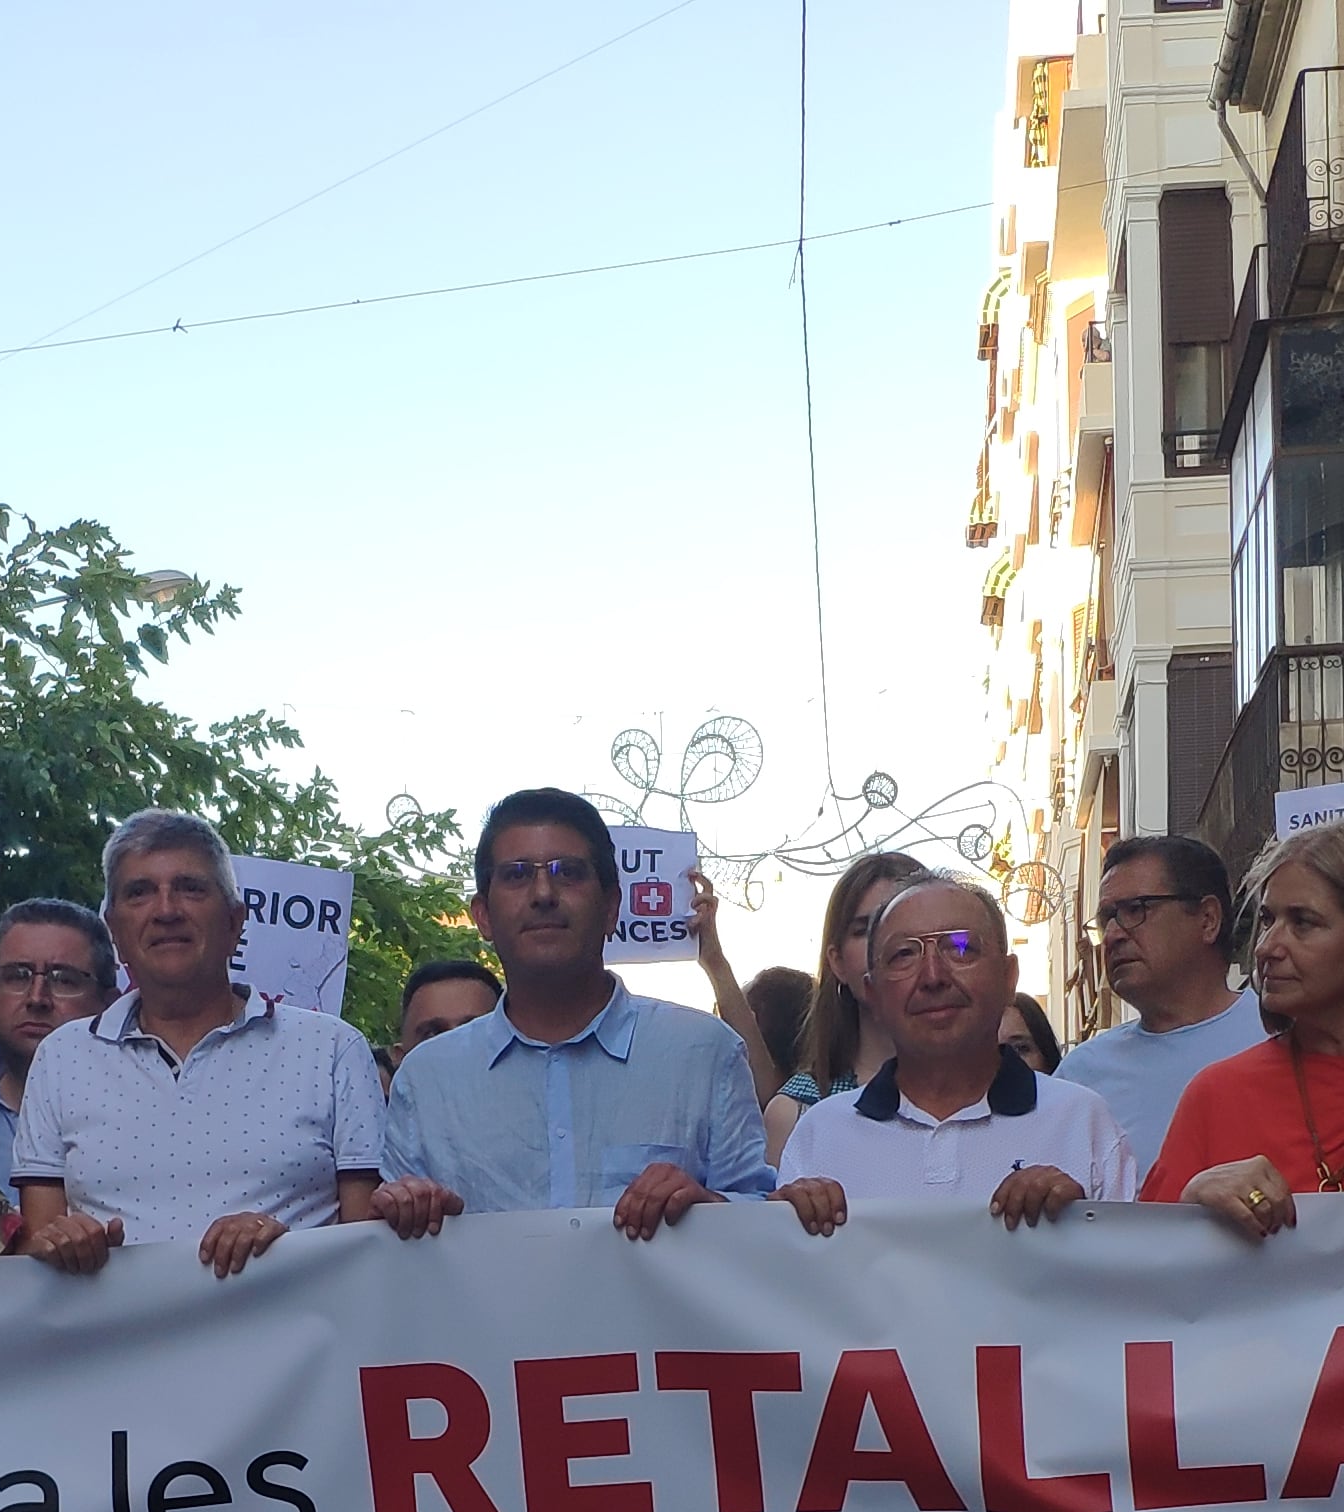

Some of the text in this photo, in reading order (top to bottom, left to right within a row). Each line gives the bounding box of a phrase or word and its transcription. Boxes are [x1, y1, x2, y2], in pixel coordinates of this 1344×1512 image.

[621, 849, 663, 873] UT
[236, 887, 342, 936] RIOR
[607, 920, 688, 943] NCES
